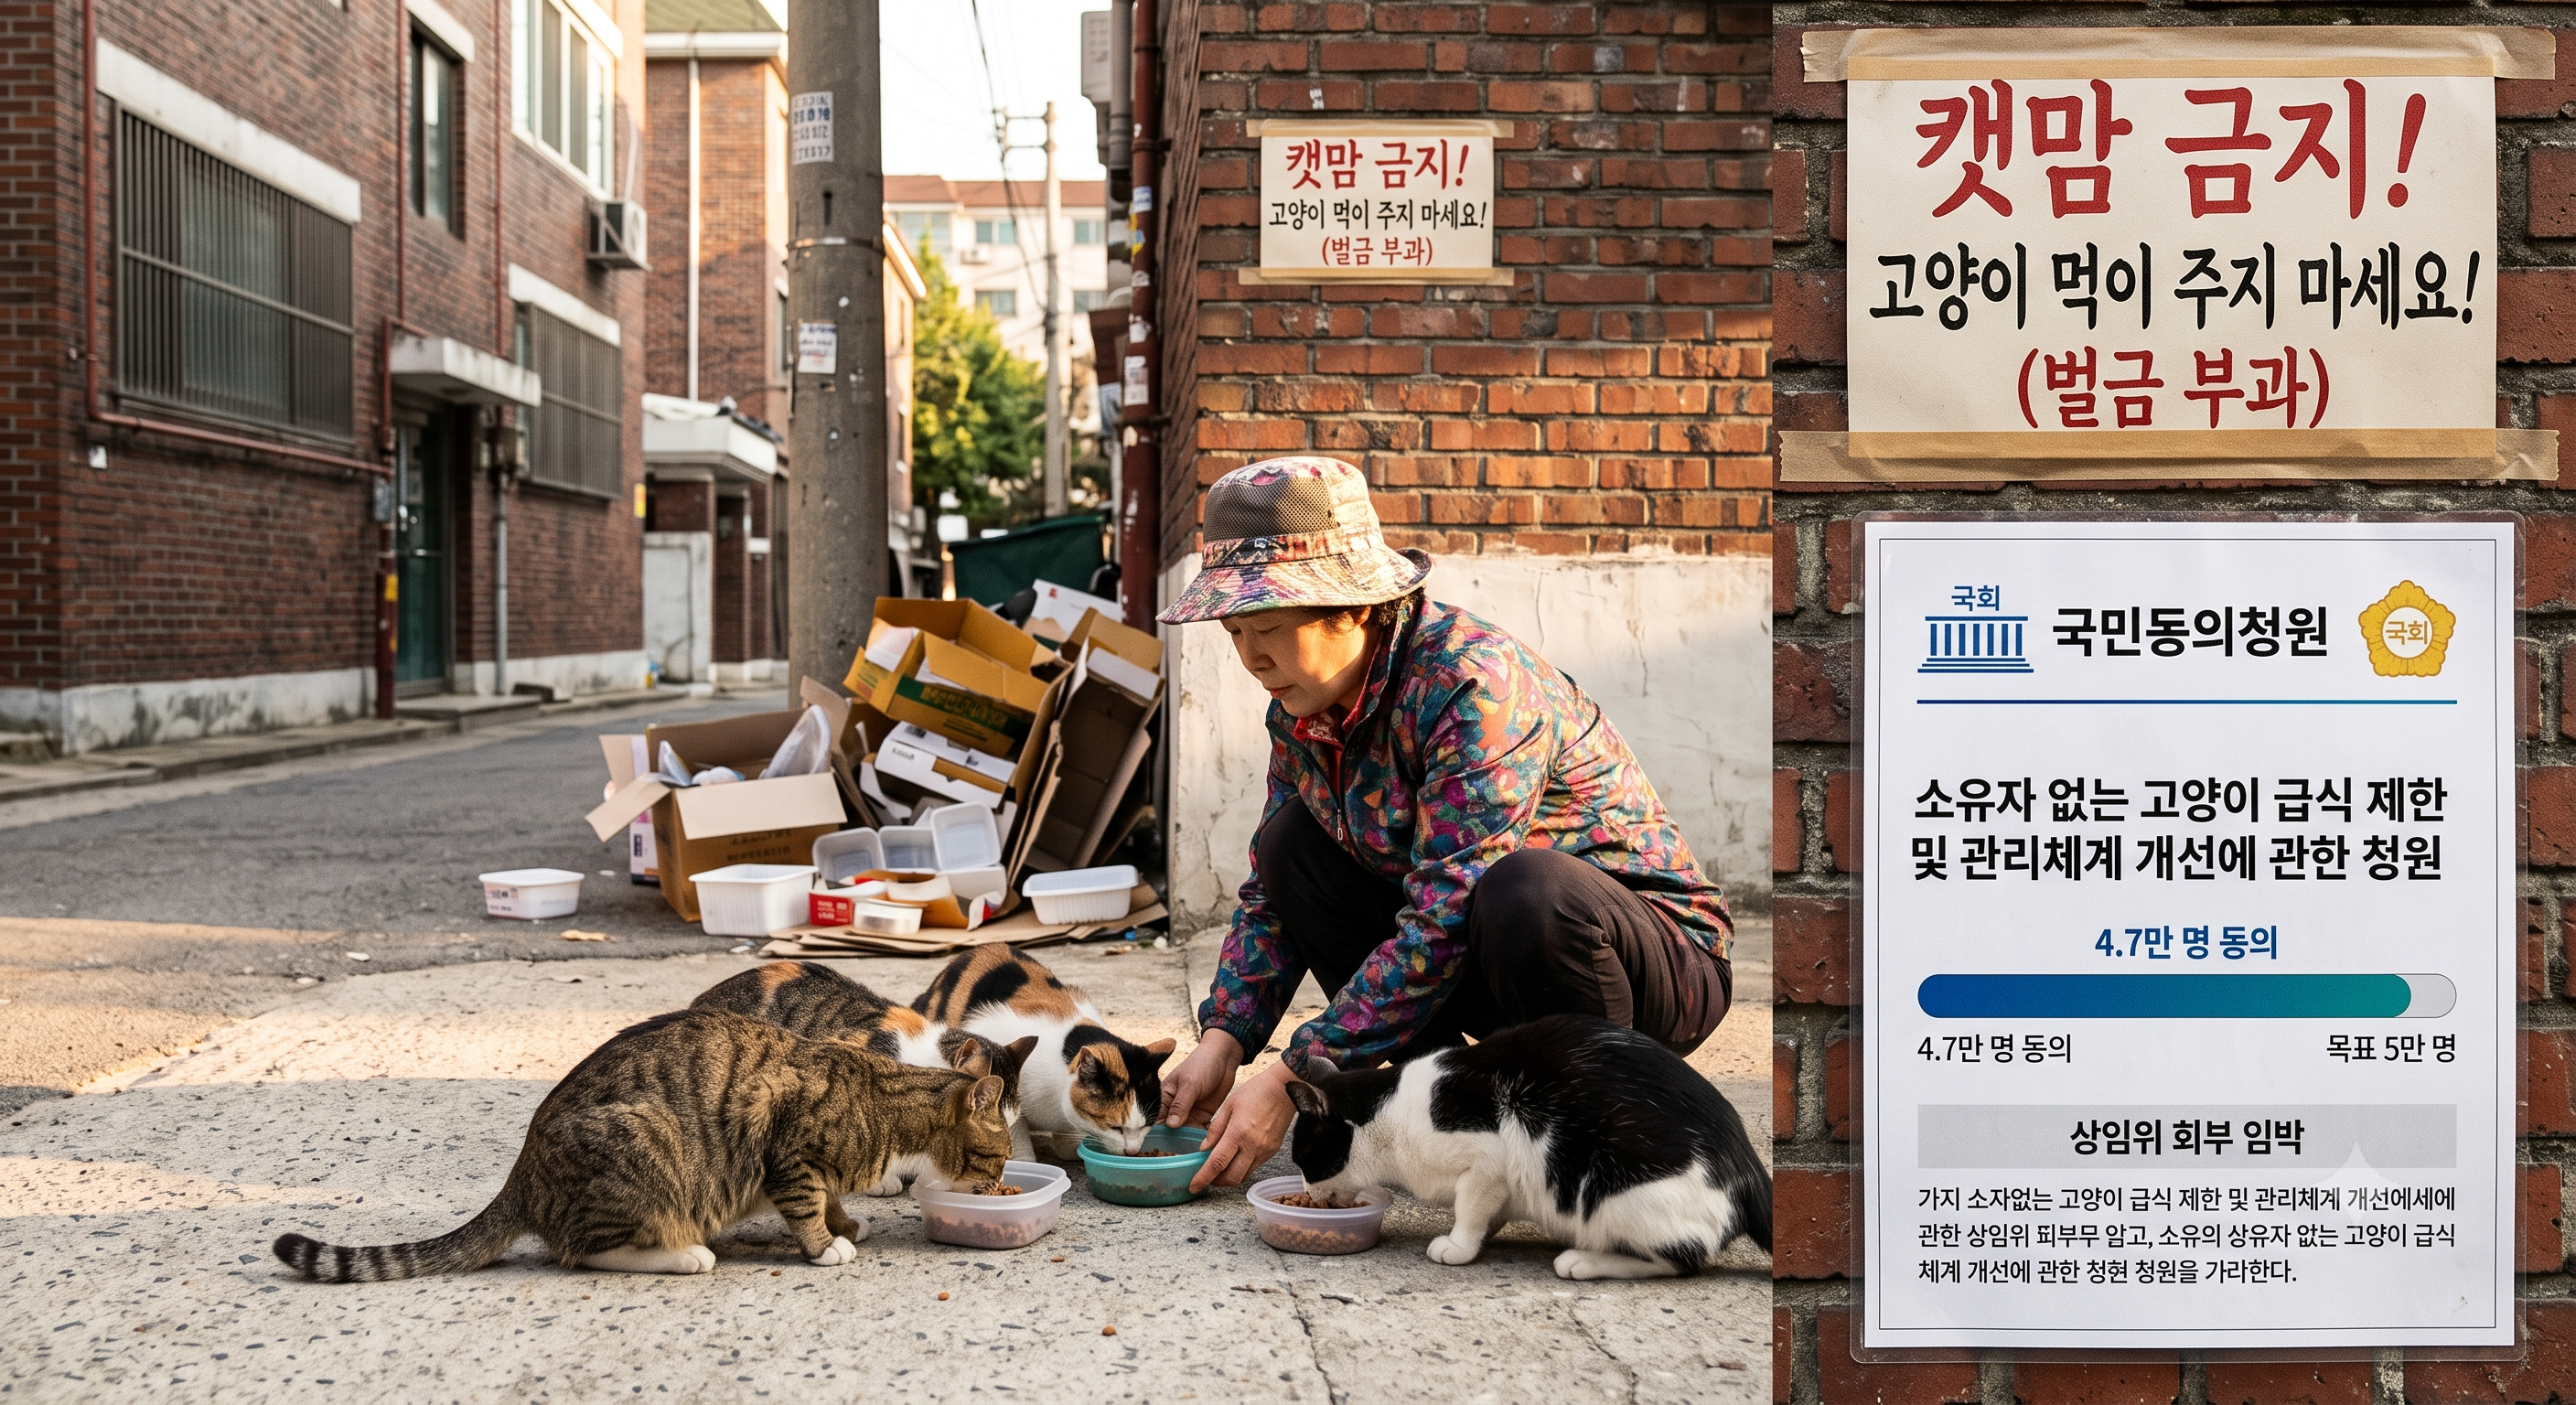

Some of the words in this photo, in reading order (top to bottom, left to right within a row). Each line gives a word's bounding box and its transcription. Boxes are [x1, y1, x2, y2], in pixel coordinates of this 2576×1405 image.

[1286, 139, 1363, 189] 캣맘
[1375, 139, 1469, 189] 금지!
[1916, 79, 2131, 219] 캣맘
[2165, 79, 2427, 220] 금지!
[1269, 199, 1324, 230] 고양이
[1334, 198, 1368, 230] 먹이
[1377, 199, 1412, 231] 주지
[1422, 199, 1487, 230] 마세요!
[1322, 236, 1373, 266] (벌금
[1380, 237, 1433, 266] 부과)
[1869, 242, 2026, 330] 고양이
[2051, 242, 2151, 330] 먹이
[2174, 241, 2274, 330] 주지
[2298, 241, 2480, 330] 마세요!
[2017, 347, 2164, 429] (벌금
[2184, 345, 2329, 429] 부과)
[1951, 585, 1999, 611] 국회
[2053, 606, 2327, 657] 국민동의청원
[2386, 619, 2428, 646] 국회
[1916, 778, 2036, 822] 소유자
[2048, 778, 2129, 821] 없는
[2141, 778, 2258, 822] 고양이
[2274, 778, 2351, 822] 급식
[2367, 778, 2447, 822] 제한
[1912, 835, 1948, 880] 및
[1960, 835, 2121, 881] 관리체계
[2136, 835, 2255, 881] 개선에
[2270, 835, 2350, 880] 관한
[2362, 835, 2441, 881] 청원
[2095, 926, 2174, 959] 4.7만
[2184, 926, 2208, 960] 명
[2219, 926, 2276, 960] 동의
[1917, 1035, 1983, 1062] 4.7만
[1991, 1034, 2012, 1063] 명
[2022, 1034, 2070, 1063] 동의
[2327, 1035, 2377, 1063] 목표
[2384, 1034, 2425, 1062] 5만
[2433, 1034, 2454, 1063] 명
[2070, 1120, 2161, 1155] 상임위
[2173, 1120, 2233, 1155] 회부
[2244, 1120, 2304, 1154] 임박
[1918, 1187, 1959, 1211] 가지
[1968, 1187, 2053, 1211] 소자없는
[2059, 1187, 2121, 1211] 고양이
[2130, 1187, 2171, 1211] 급식
[2179, 1187, 2222, 1211] 제한
[2229, 1187, 2248, 1211] 및
[2255, 1187, 2340, 1211] 관리체계
[2348, 1187, 2454, 1211] 개선에세에
[1918, 1223, 1961, 1247] 관한
[1967, 1224, 2029, 1248] 상임위
[2158, 1224, 2220, 1248] 소유의
[2227, 1224, 2292, 1248] 상유자
[2345, 1223, 2406, 1248] 고양이
[2414, 1224, 2454, 1247] 급식
[1919, 1260, 1960, 1283] 체계
[1968, 1260, 2030, 1283] 개선에
[2037, 1260, 2080, 1283] 관한
[2135, 1260, 2198, 1283] 청원을
[2206, 1259, 2296, 1283] 가라한다.
